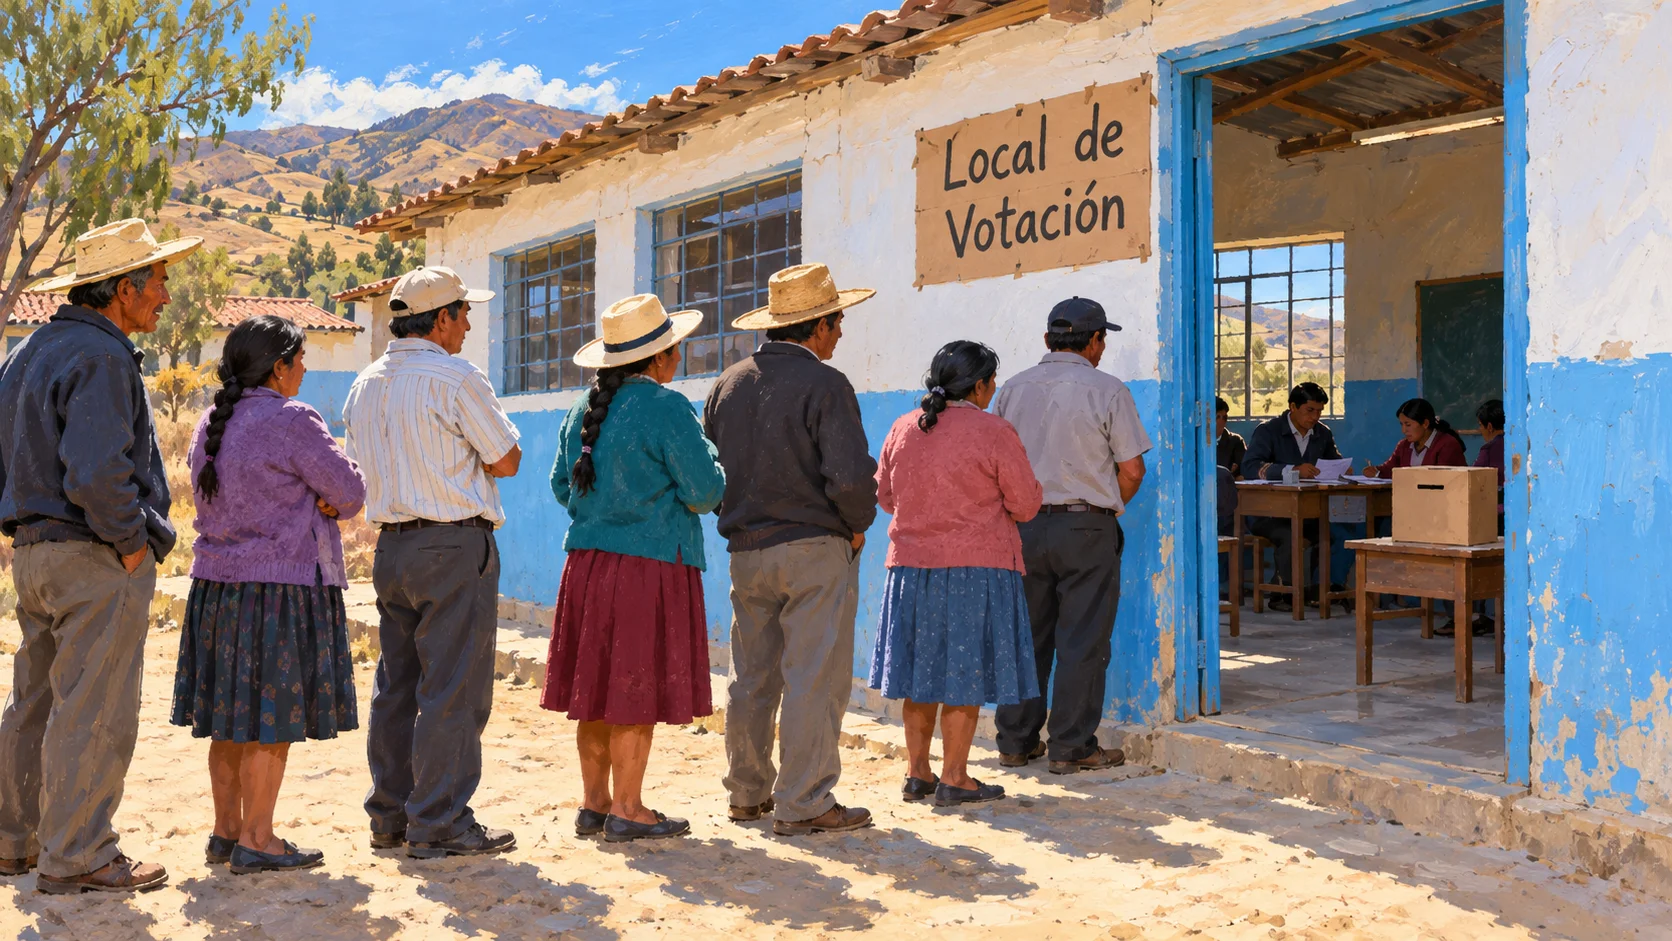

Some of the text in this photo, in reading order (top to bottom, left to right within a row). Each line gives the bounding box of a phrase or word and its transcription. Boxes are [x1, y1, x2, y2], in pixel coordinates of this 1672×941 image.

[944, 102, 1124, 192] Local de
[945, 179, 1125, 258] Votación
